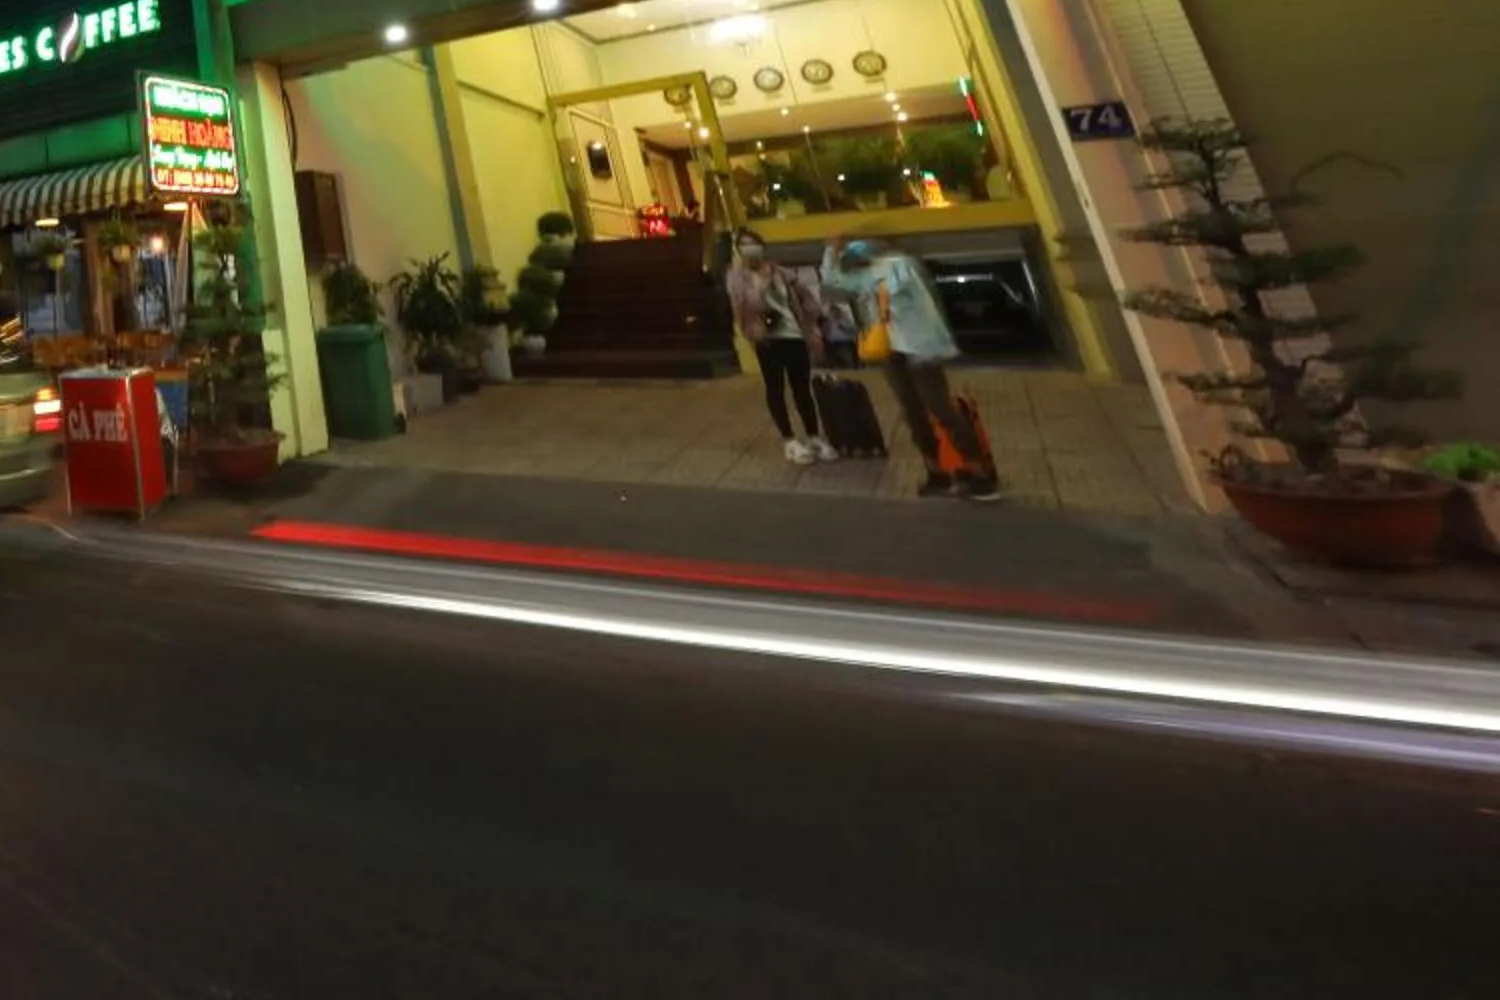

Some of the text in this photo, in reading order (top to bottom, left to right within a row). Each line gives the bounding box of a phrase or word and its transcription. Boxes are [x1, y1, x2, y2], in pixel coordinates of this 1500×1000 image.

[1070, 104, 1123, 131] 74
[67, 399, 130, 443] CÀ PHÊ
